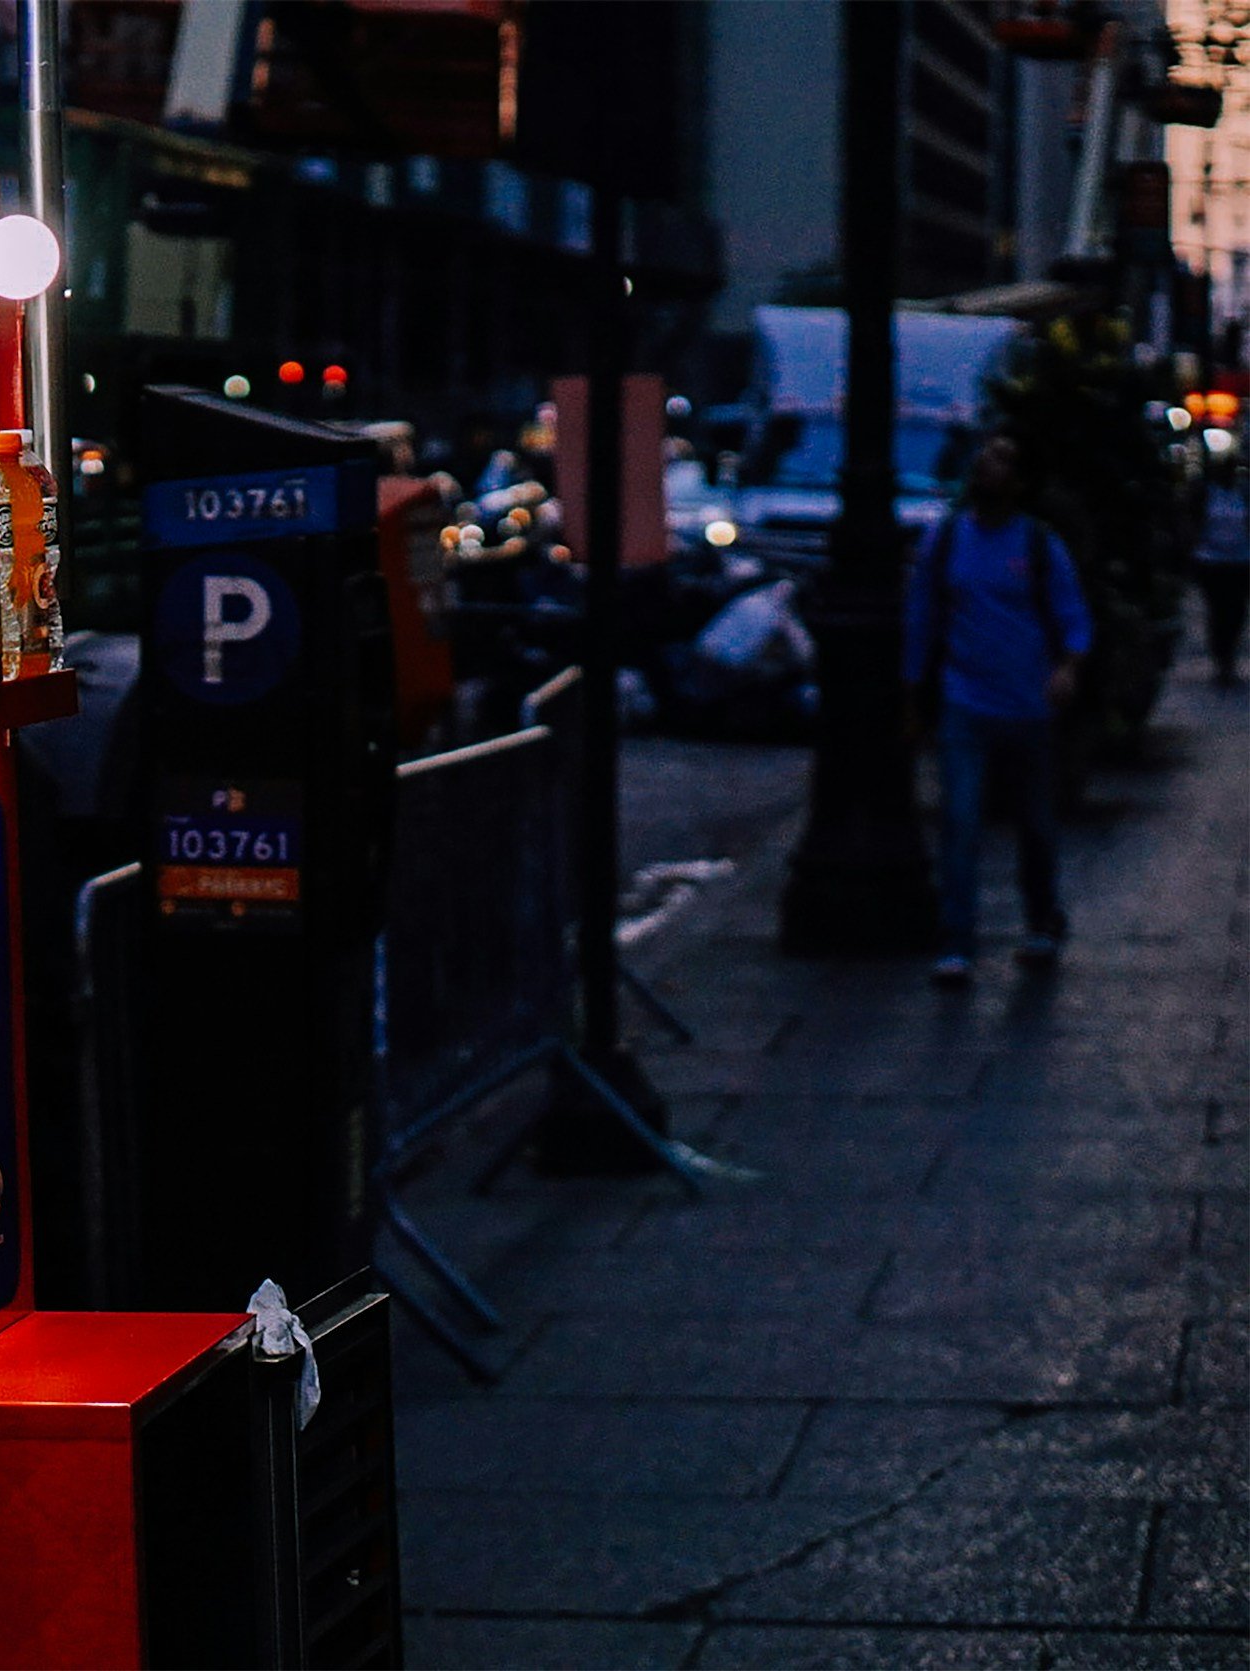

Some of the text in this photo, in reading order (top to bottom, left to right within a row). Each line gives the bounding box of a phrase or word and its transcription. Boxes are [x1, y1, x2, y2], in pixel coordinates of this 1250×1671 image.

[183, 487, 307, 521] 103761
[202, 574, 273, 685] P
[168, 828, 290, 861] 103761
